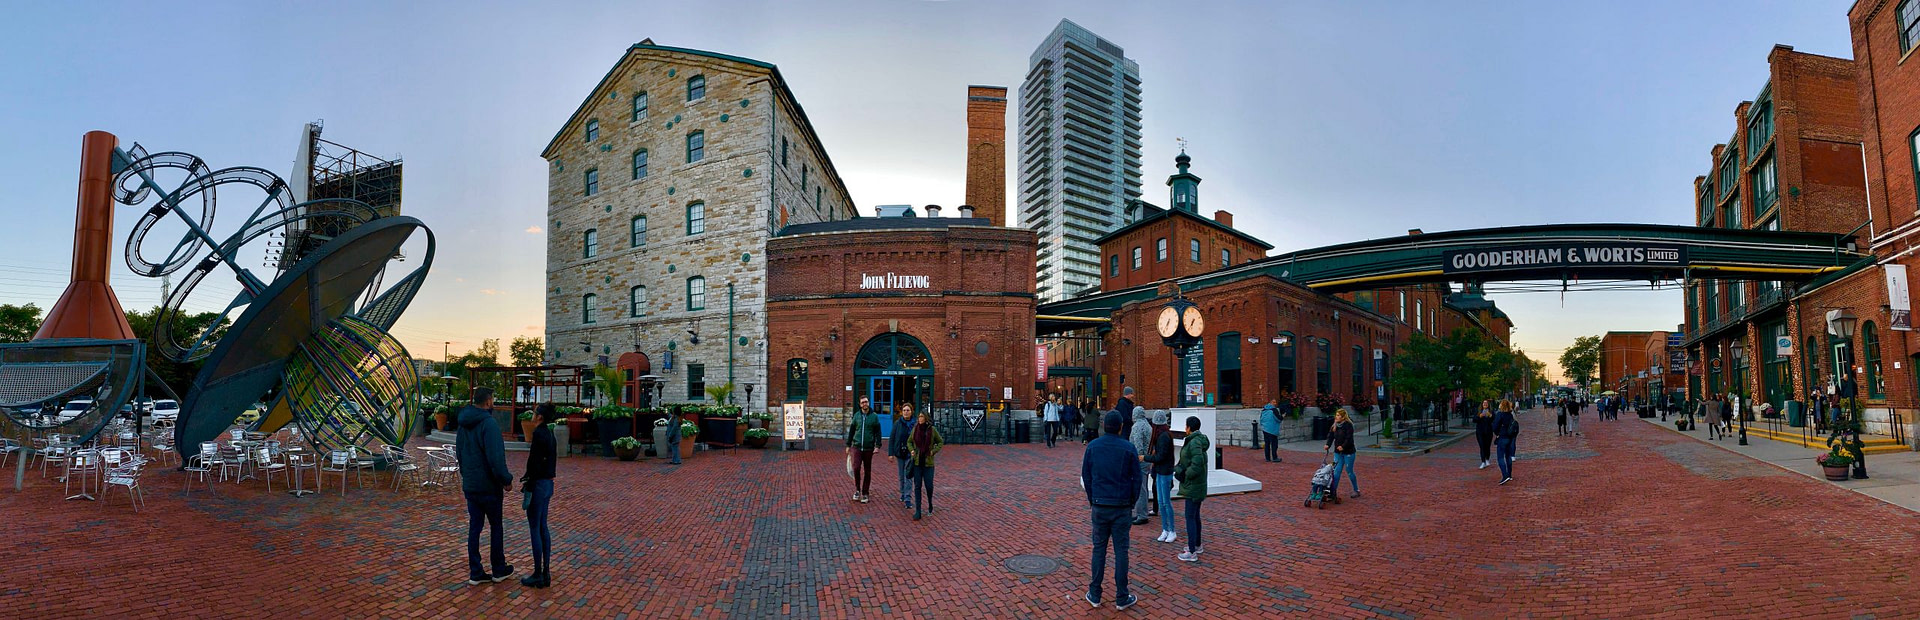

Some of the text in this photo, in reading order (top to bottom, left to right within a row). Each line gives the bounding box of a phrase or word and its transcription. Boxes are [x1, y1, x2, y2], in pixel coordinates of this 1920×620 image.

[1453, 248, 1679, 269] GOODERHAM & WORTS LIMITED
[860, 272, 930, 289] JOHN FLUEVOG
